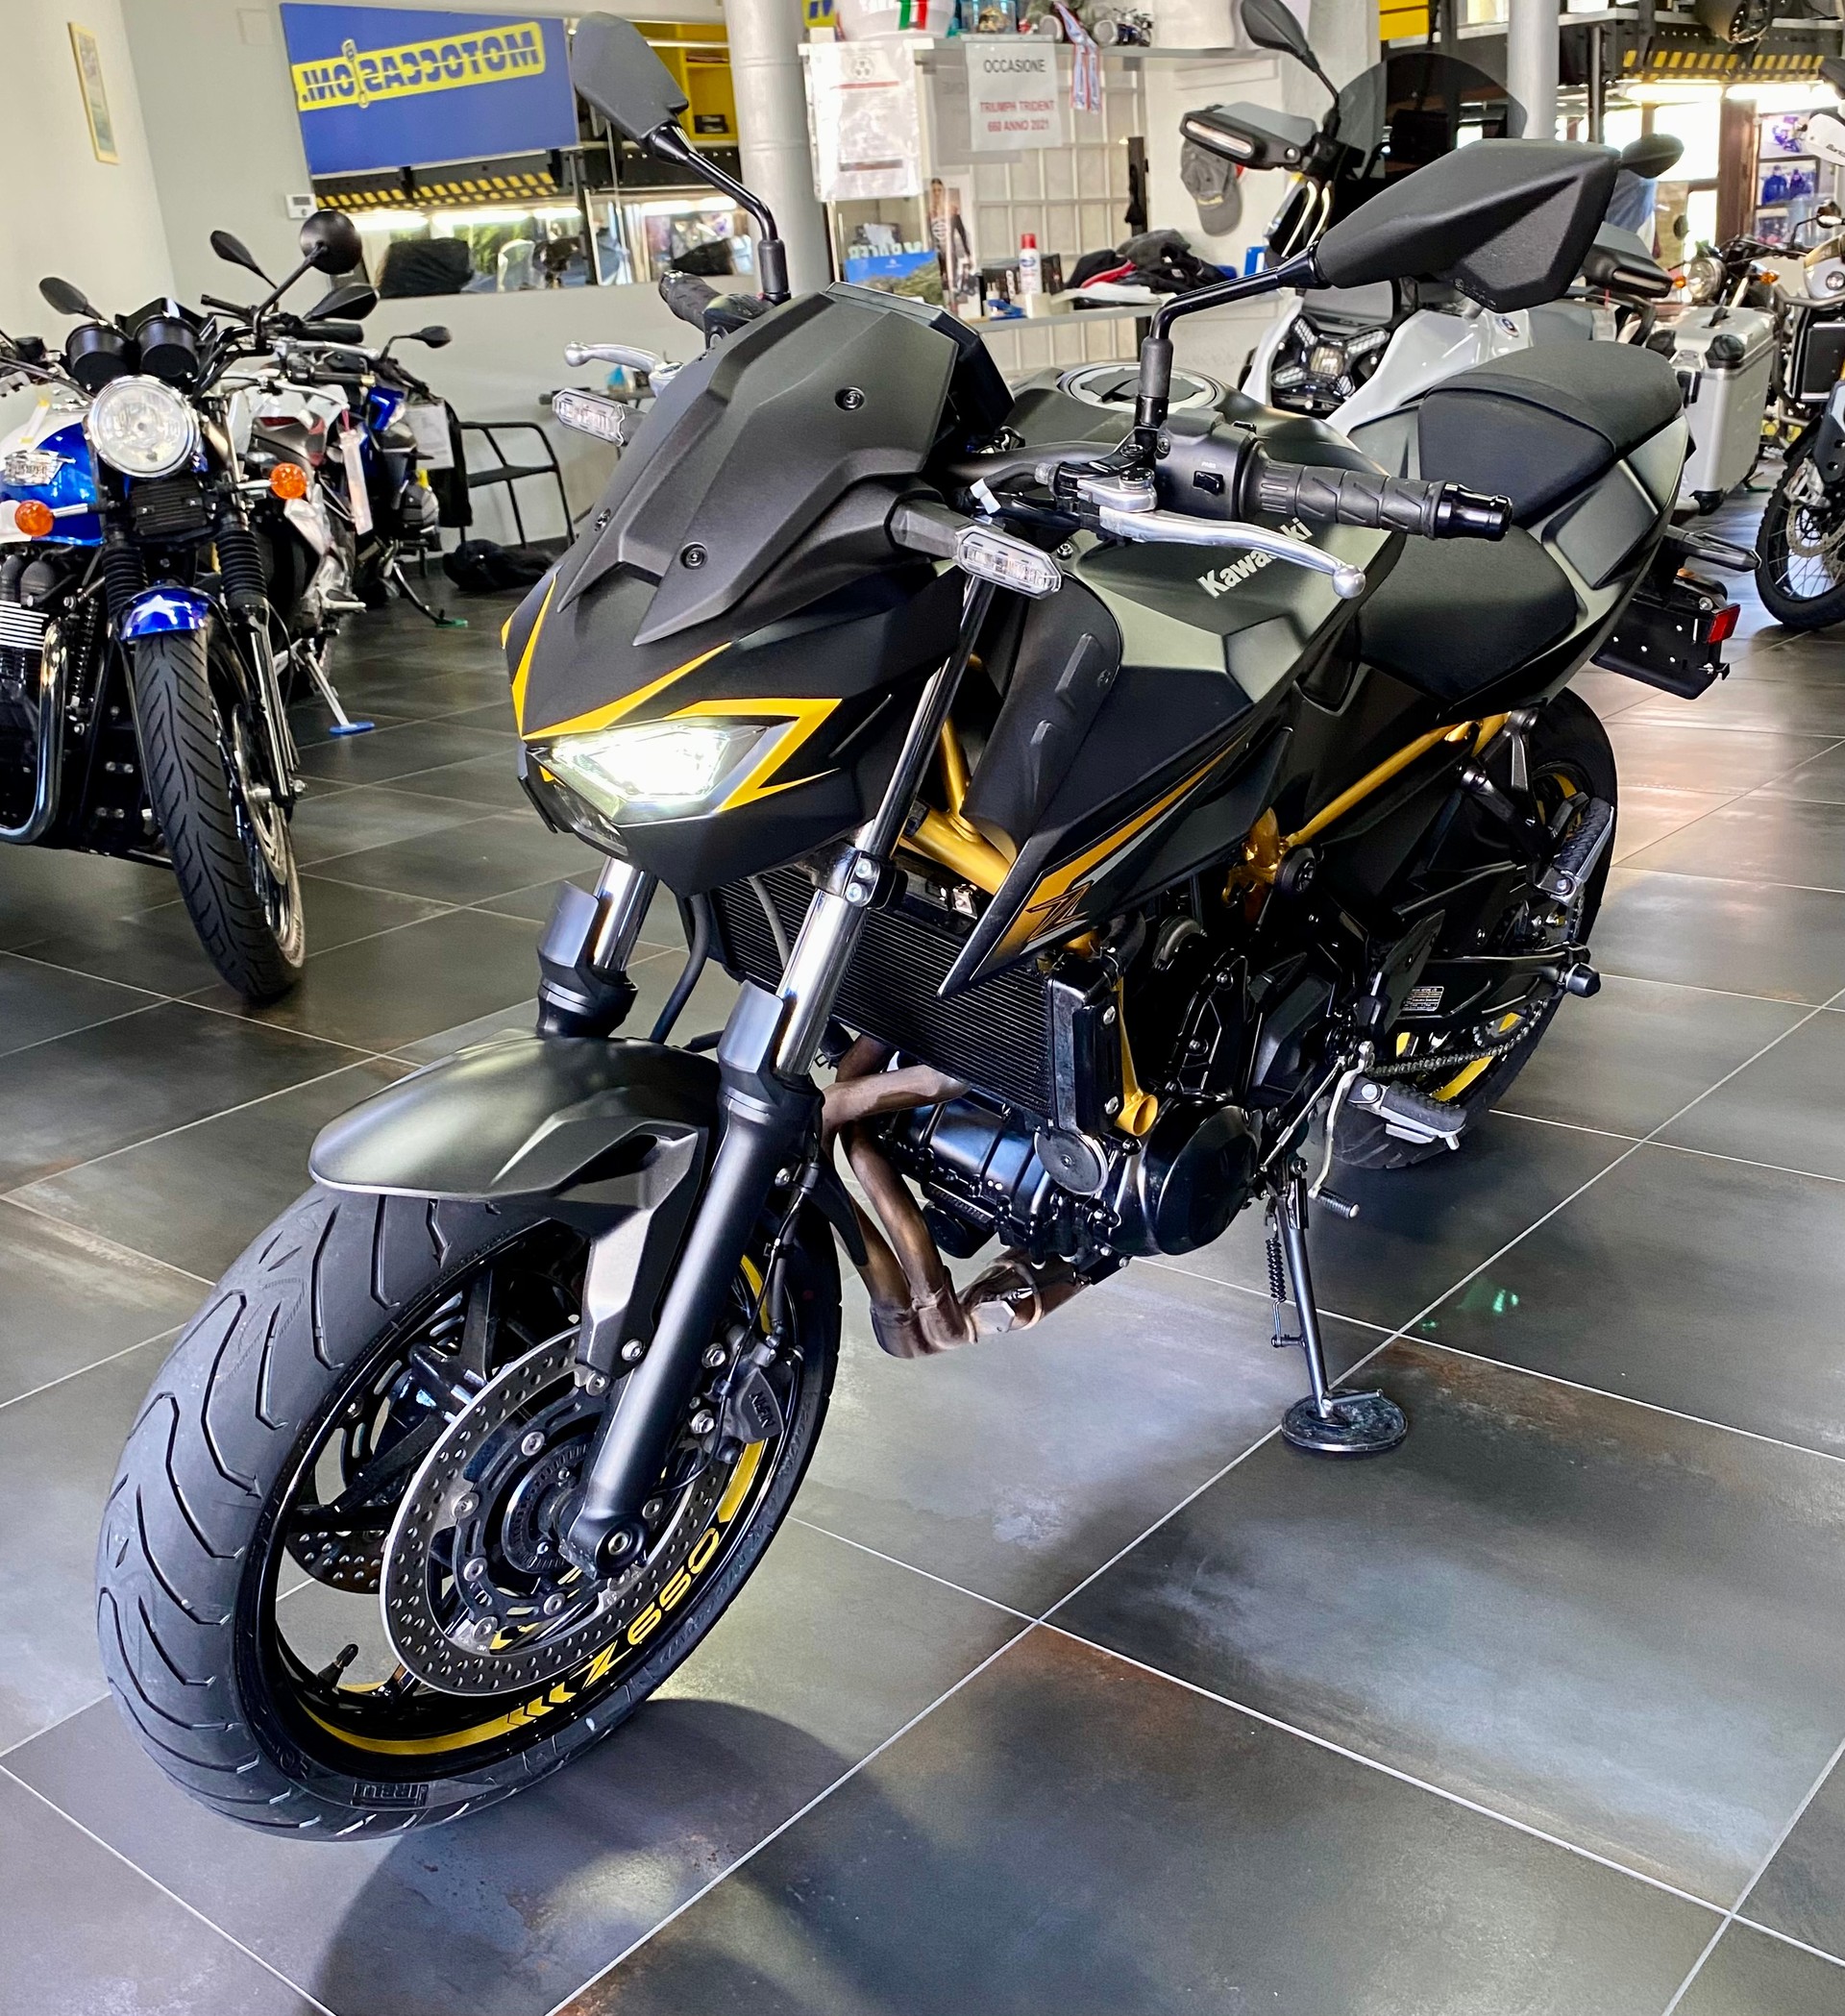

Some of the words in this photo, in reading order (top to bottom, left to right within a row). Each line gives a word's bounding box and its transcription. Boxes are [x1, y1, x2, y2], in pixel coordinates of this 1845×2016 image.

[983, 59, 1046, 73] OCCASIONE
[980, 101, 1017, 112] TRIUMPH
[1019, 100, 1054, 111] TRIDENT
[1003, 120, 1029, 132] ANNO
